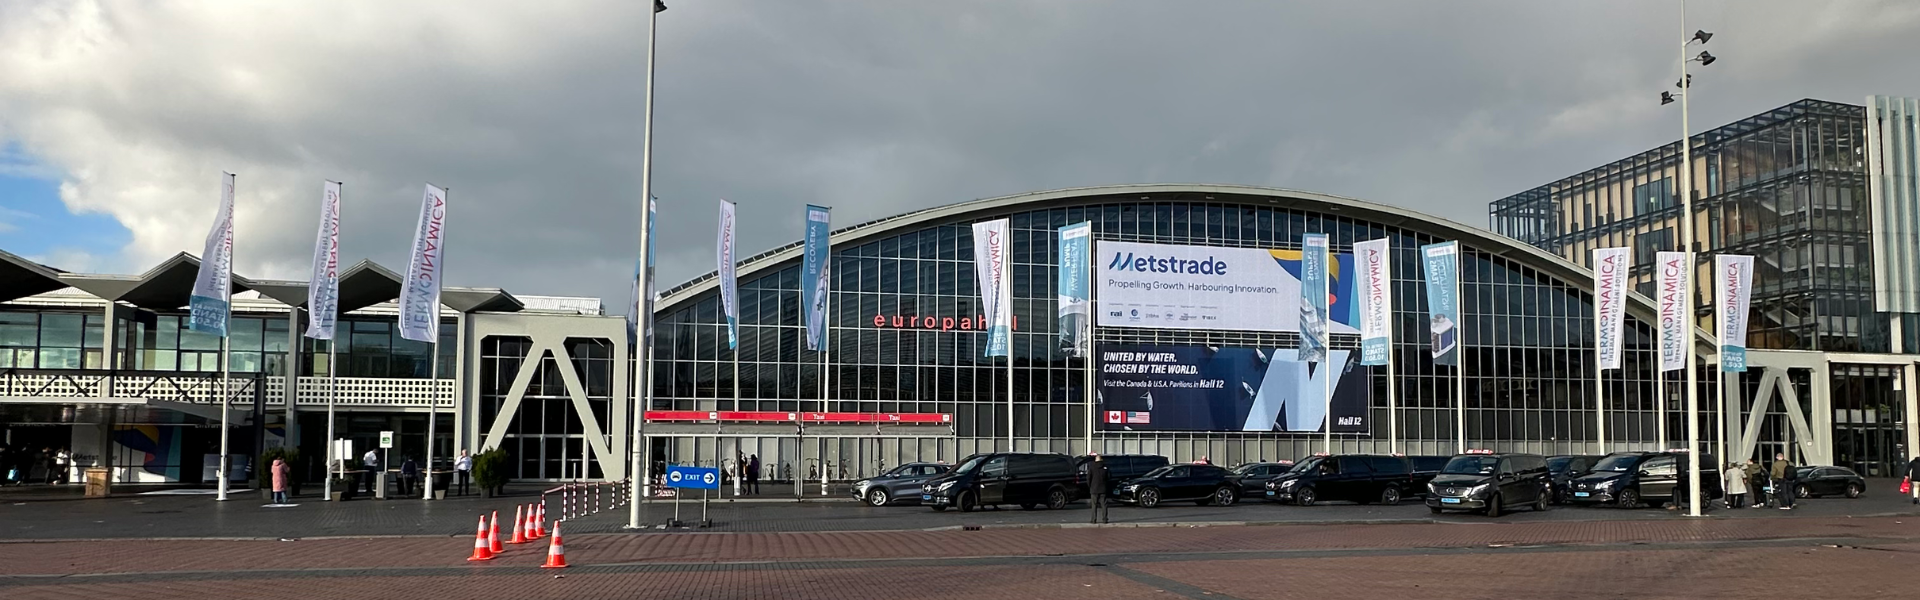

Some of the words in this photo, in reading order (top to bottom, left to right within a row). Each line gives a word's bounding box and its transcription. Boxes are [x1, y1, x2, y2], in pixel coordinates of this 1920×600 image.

[1109, 251, 1227, 275] Metstrade
[1108, 279, 1151, 291] Propelling
[1153, 281, 1186, 291] Growth.
[1188, 283, 1234, 293] Harbouring
[874, 314, 1018, 332] europahl
[1103, 352, 1134, 362] UNITED
[1135, 352, 1147, 362] BY
[1147, 353, 1177, 363] WATER.
[1103, 363, 1137, 374] CHOSEN
[1138, 364, 1150, 374] BY
[1150, 364, 1166, 374] THE
[1167, 365, 1199, 375] WORLD.
[1126, 380, 1147, 388] Canada
[1193, 380, 1199, 388] in
[1200, 379, 1215, 389] Hall
[1216, 379, 1224, 389] 12
[1338, 416, 1353, 426] Hall
[1354, 416, 1362, 426] 12
[685, 473, 700, 481] EXIT
